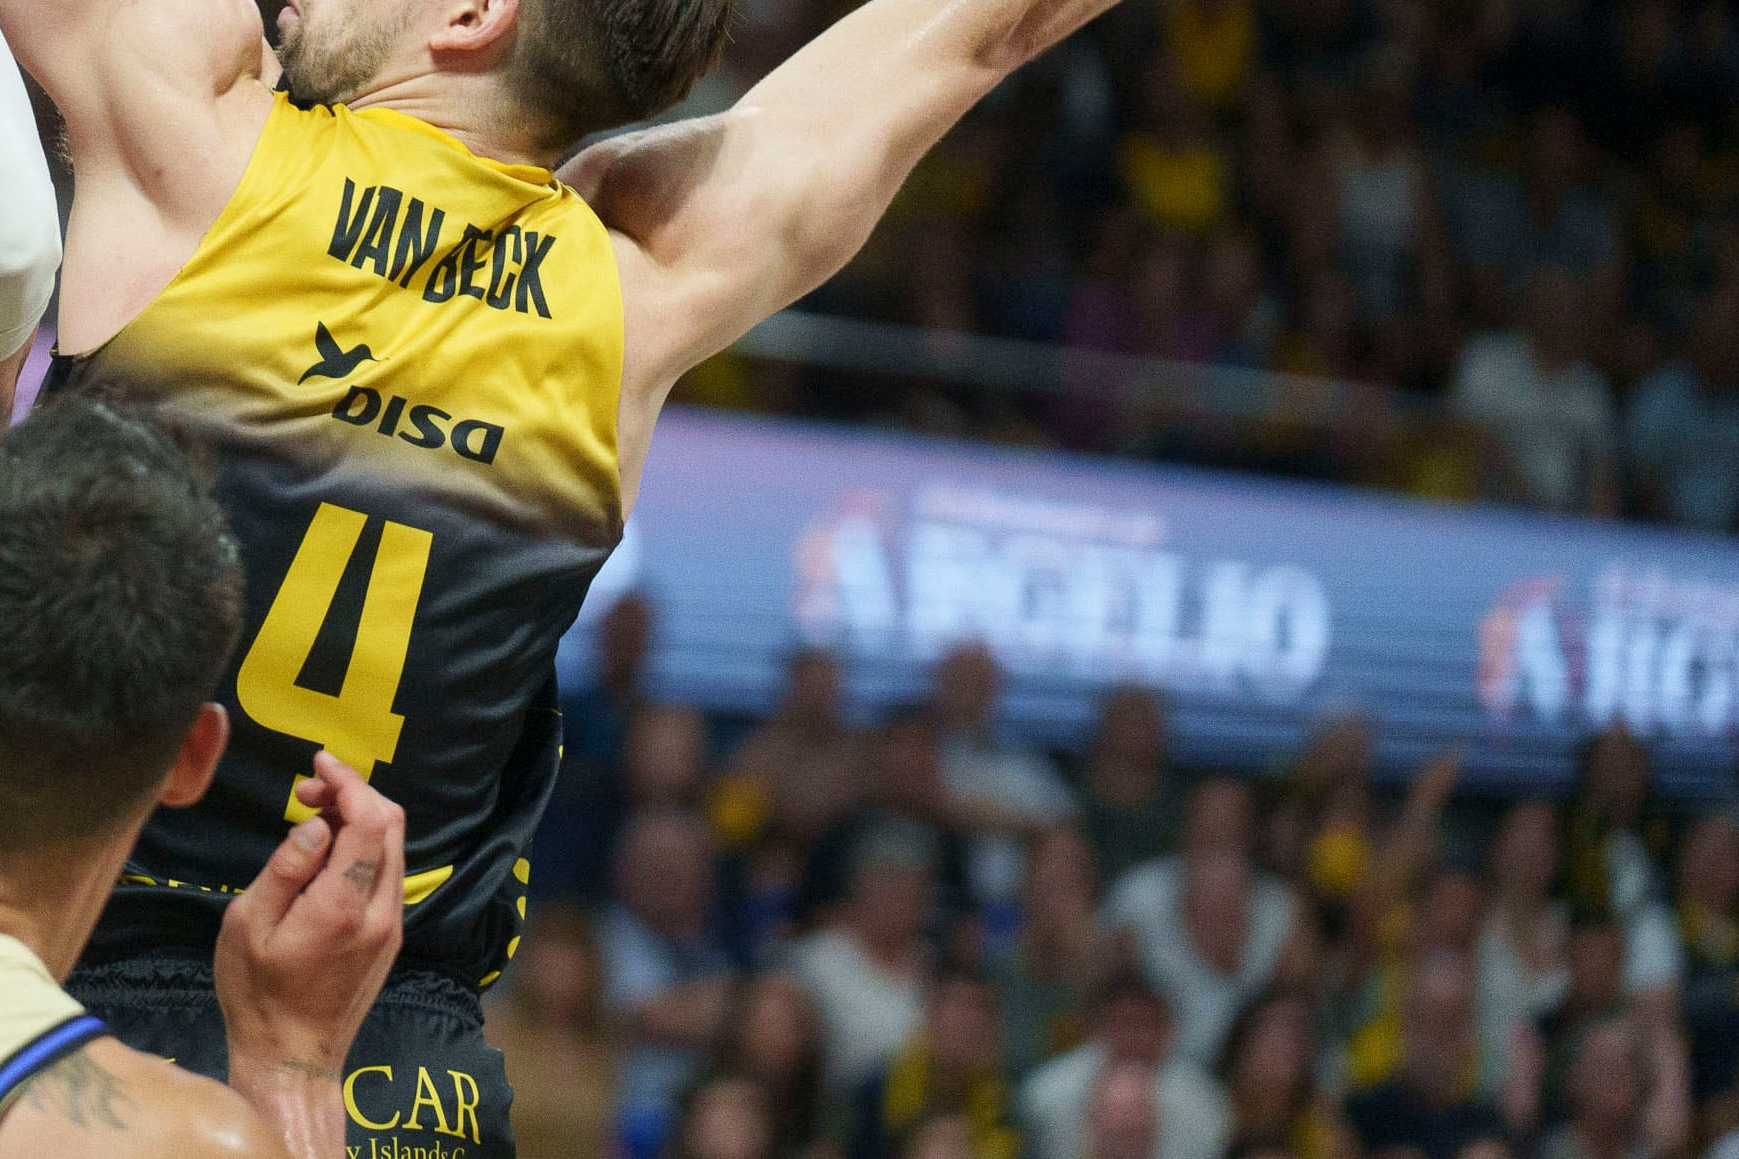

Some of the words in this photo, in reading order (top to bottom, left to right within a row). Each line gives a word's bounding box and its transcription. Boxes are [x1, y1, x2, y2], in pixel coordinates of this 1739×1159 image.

[327, 176, 446, 290] VAN
[422, 222, 557, 320] BECK
[236, 501, 433, 824] 4
